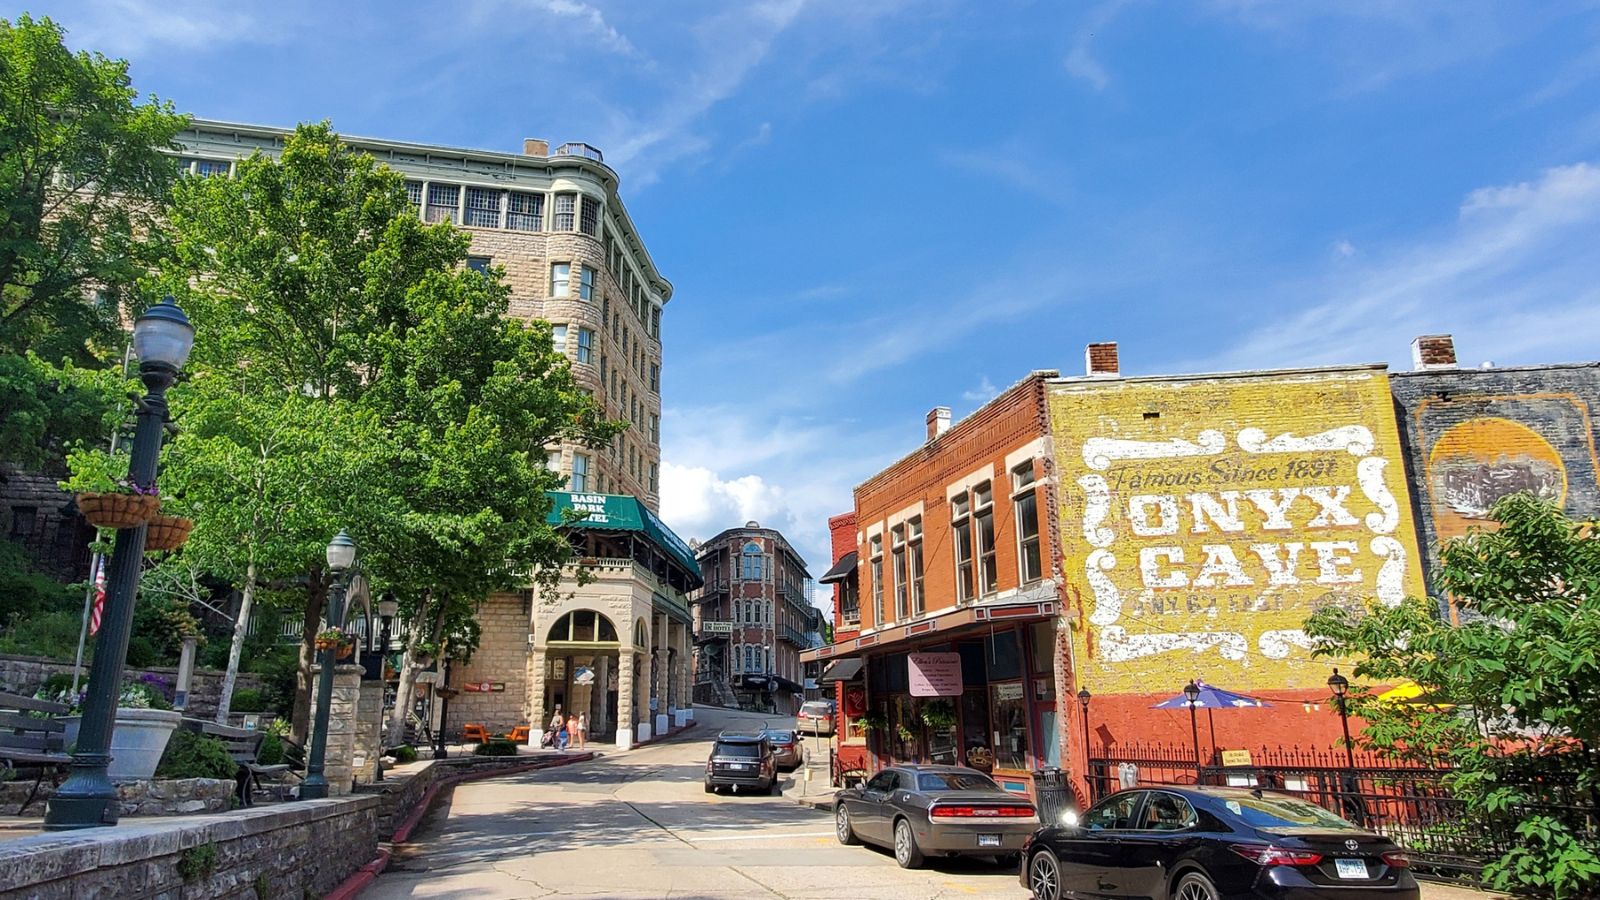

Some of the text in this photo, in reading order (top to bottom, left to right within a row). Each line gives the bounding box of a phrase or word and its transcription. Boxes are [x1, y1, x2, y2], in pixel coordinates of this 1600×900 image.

[1107, 466, 1202, 490] Famous
[1208, 457, 1277, 485] Since
[570, 494, 607, 504] BASIN
[573, 503, 606, 513] PARK
[570, 513, 609, 523] TEL
[1127, 485, 1360, 538] ONYX
[1139, 540, 1363, 592] CAVE
